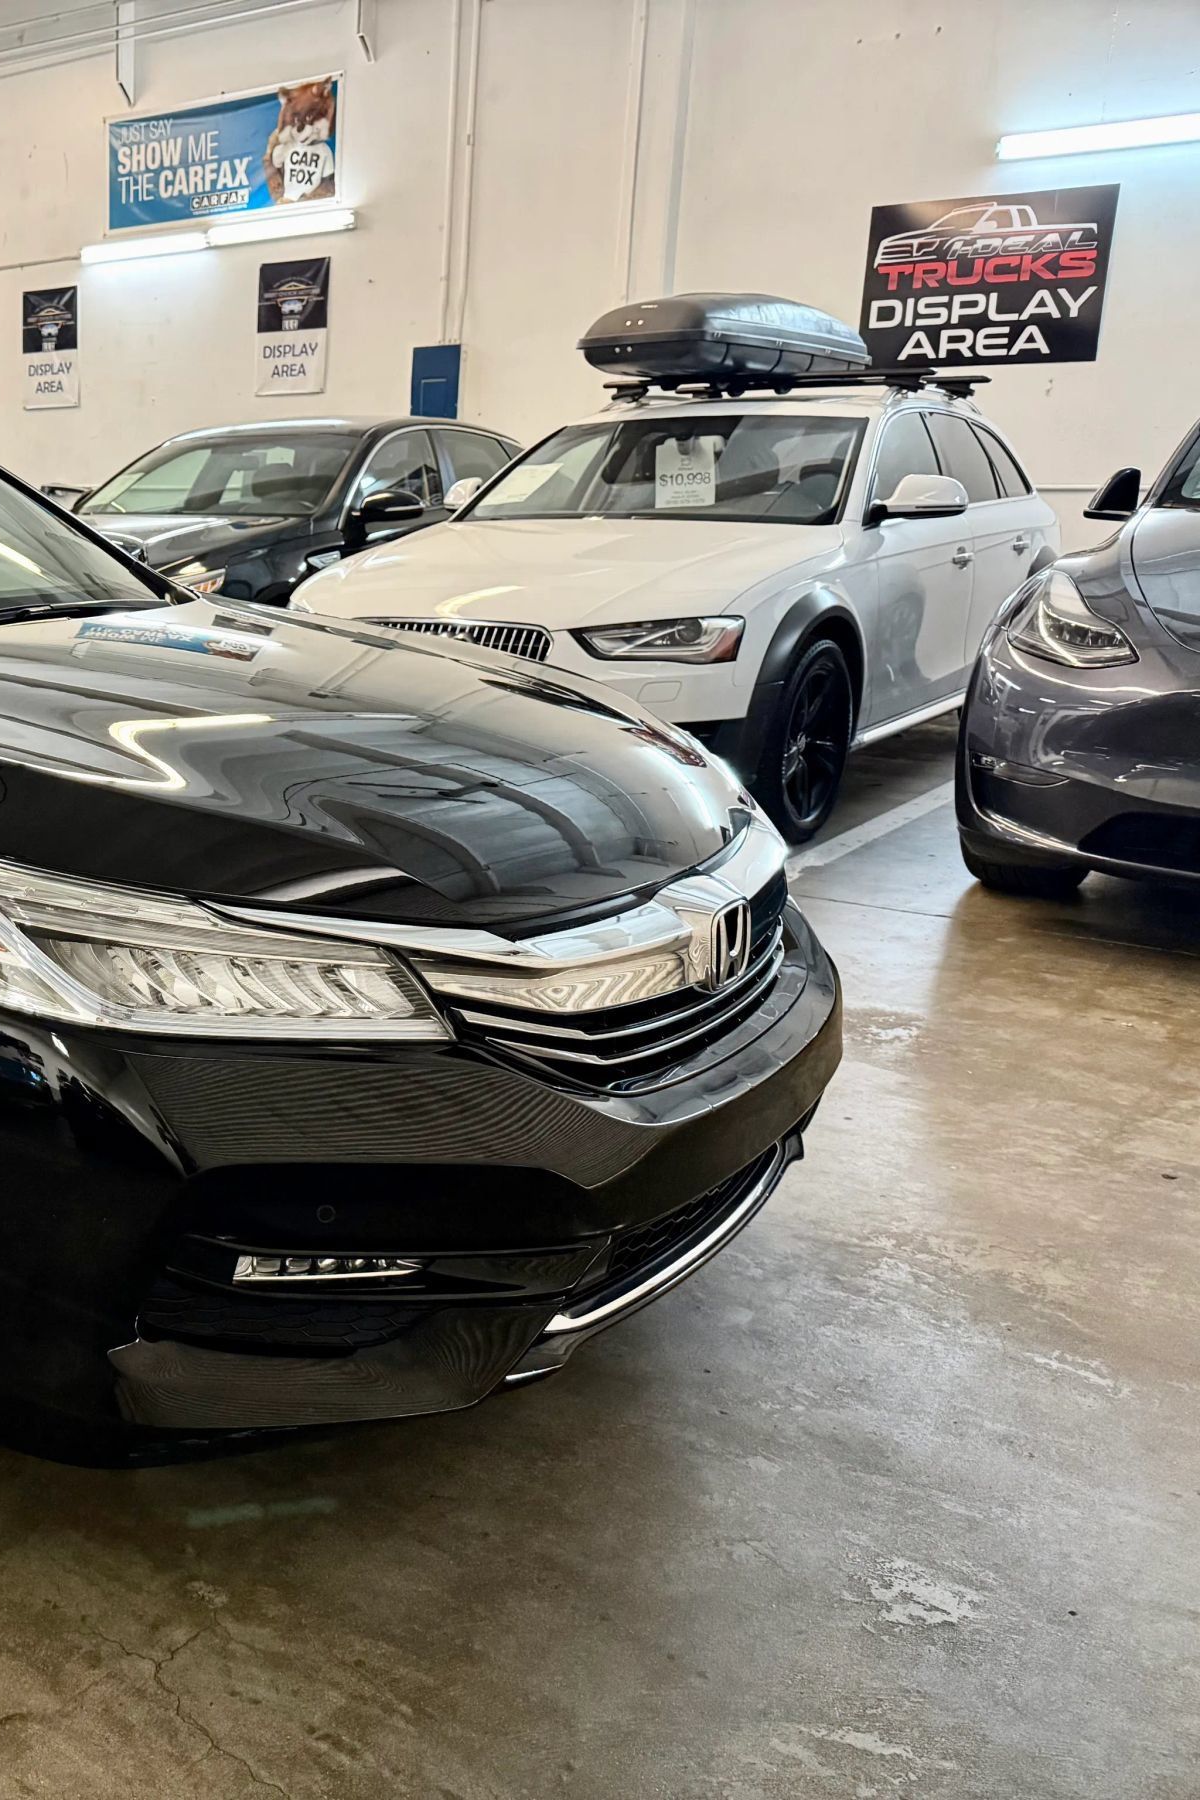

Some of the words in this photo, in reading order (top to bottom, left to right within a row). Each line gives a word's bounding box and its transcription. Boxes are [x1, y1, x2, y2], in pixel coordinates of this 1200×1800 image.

[120, 123, 147, 145] JUST
[149, 118, 173, 139] SAY
[117, 137, 183, 174] SHOW
[188, 131, 219, 163] ME
[290, 151, 320, 168] CAR
[117, 173, 154, 204] THE
[159, 158, 250, 199] CARFAX
[289, 169, 316, 185] FOX
[192, 190, 249, 209] CARFAX
[877, 250, 1098, 291] TRUCKS
[868, 286, 1098, 329] DISPLAY
[262, 342, 319, 359] DISPLAY
[897, 325, 1050, 361] AREA
[28, 361, 72, 377] DISPLAY
[271, 363, 307, 378] AREA
[35, 380, 64, 394] AREA
[659, 472, 711, 487] $10,998
